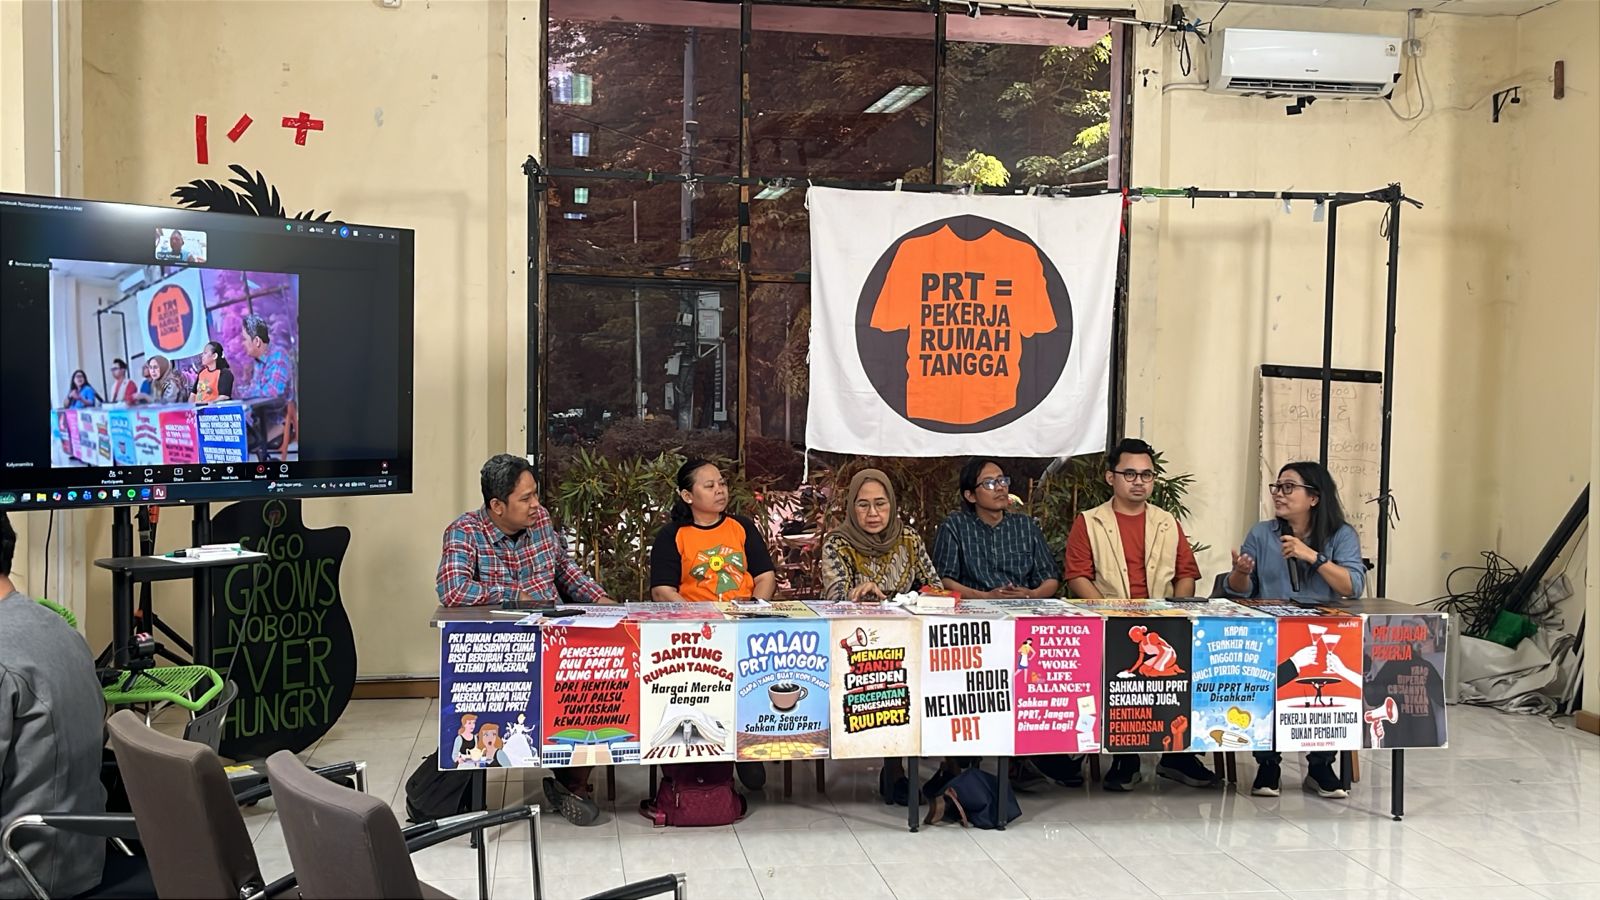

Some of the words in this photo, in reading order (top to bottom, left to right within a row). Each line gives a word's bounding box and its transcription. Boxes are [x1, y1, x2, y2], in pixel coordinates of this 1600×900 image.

[921, 272, 985, 301] PRT
[921, 303, 1010, 327] PEKERJA
[921, 328, 1010, 351] RUMAH
[920, 353, 1008, 377] TANGGA
[224, 558, 336, 615] GROWS
[228, 609, 327, 645] NOBODY
[1031, 625, 1056, 635] PRT
[1058, 625, 1090, 635] JUGA
[1224, 626, 1248, 636] KAPAN
[448, 633, 464, 643] PRT
[465, 633, 492, 643] BUKAN
[492, 633, 536, 642] CINDERELLA
[671, 633, 701, 645] PRT
[929, 621, 991, 648] NEGARA
[450, 643, 471, 652] YANG
[472, 643, 510, 652] NASIBNYA
[512, 643, 534, 652] CUMA
[750, 632, 817, 657] KALAU
[1040, 637, 1080, 646] LAYAK
[1207, 639, 1243, 652] TERAKHIR
[1245, 640, 1263, 652] KALI
[448, 653, 466, 663] BISA
[468, 653, 503, 663] BERUBAH
[504, 652, 536, 662] SETELAH
[560, 646, 625, 658] PENGESAHAN
[651, 647, 722, 664] JANTUNG
[851, 648, 903, 664] MENAGIH
[1039, 648, 1080, 658] PUNYA
[1210, 652, 1243, 665] ANGGOTA
[1244, 653, 1259, 664] DPR
[1372, 644, 1412, 660] PEKERJA
[212, 636, 332, 694] EVER
[559, 659, 582, 669] RUU
[584, 658, 611, 669] PPRT
[613, 658, 624, 668] DI
[740, 656, 768, 676] PRT
[774, 654, 828, 670] MOGOK
[930, 646, 982, 672] HARUS
[454, 663, 485, 673] KETEMU
[486, 662, 528, 673] PANGERAN,
[642, 663, 685, 684] RUMAH
[687, 662, 734, 682] TANGGA
[856, 661, 894, 673] JANJI
[1214, 665, 1240, 676] PIRING
[1242, 665, 1275, 682] SENDIRI?
[555, 670, 591, 681] UJUNG
[594, 669, 629, 680] WAKTU
[847, 670, 904, 689] PRESIDEN
[967, 669, 1008, 692] HADIR
[1047, 671, 1072, 681] LIFE
[451, 682, 482, 693] JANGAN
[483, 682, 532, 692] PERLAKUKAN
[554, 682, 579, 692] DPR!
[581, 681, 630, 691] HENTIKAN
[652, 682, 688, 695] Hargai
[691, 681, 732, 693] Mereka
[739, 682, 758, 697] SIAPA
[758, 674, 775, 685] YANG
[776, 672, 794, 680] BUAT
[795, 672, 810, 680] KOPI
[1109, 681, 1144, 693] SAHKAN
[1146, 681, 1164, 692] RUU
[1166, 680, 1188, 692] PPRT
[1196, 683, 1216, 692] RUU
[1218, 683, 1241, 692] PPRT
[1244, 683, 1269, 692] Harus
[452, 692, 484, 703] MEREKA
[485, 692, 510, 702] TANPA
[511, 692, 531, 701] HAK!
[558, 693, 588, 704] JANJI
[670, 693, 709, 706] dengan
[848, 688, 906, 706] PERCEPATAN
[925, 690, 1011, 717] MELINDUNGI
[1017, 698, 1048, 707] Sahkan
[1050, 698, 1068, 707] RUU
[1109, 694, 1154, 706] SEKARANG
[1156, 693, 1180, 706] JUGA,
[1210, 692, 1255, 702] Disahkan!
[455, 702, 487, 712] SAHKAN
[488, 702, 505, 712] RUU
[505, 702, 528, 712] PPRT!
[564, 704, 621, 715] TUNTASKAN
[852, 698, 902, 713] PENGESAHAN
[222, 685, 334, 741] HUNGRY
[758, 715, 776, 724] DPR,
[780, 714, 808, 724] Segera
[1017, 710, 1042, 721] PPRT,
[1043, 709, 1074, 720] Jangan
[1109, 708, 1152, 720] HENTIKAN
[1280, 713, 1307, 725] PEKERJA
[1310, 712, 1331, 724] RUMAH
[1334, 712, 1358, 724] TANGGA
[553, 714, 630, 727] KEWAJIBANMU!
[745, 724, 774, 732] Sahkan
[778, 722, 794, 731] RUU
[797, 721, 821, 730] PPRT!
[849, 713, 875, 732] RUU
[1017, 722, 1050, 732] Ditunda
[1052, 721, 1073, 732] Lagi!
[1109, 721, 1164, 733] PENINDASAN
[951, 716, 981, 742] PRT
[1291, 727, 1312, 739] BUKAN
[1314, 726, 1347, 739] PEMBANTU
[1109, 734, 1149, 746] PEKERJA!
[642, 745, 680, 759] RUU
[686, 744, 725, 757] PPRT
